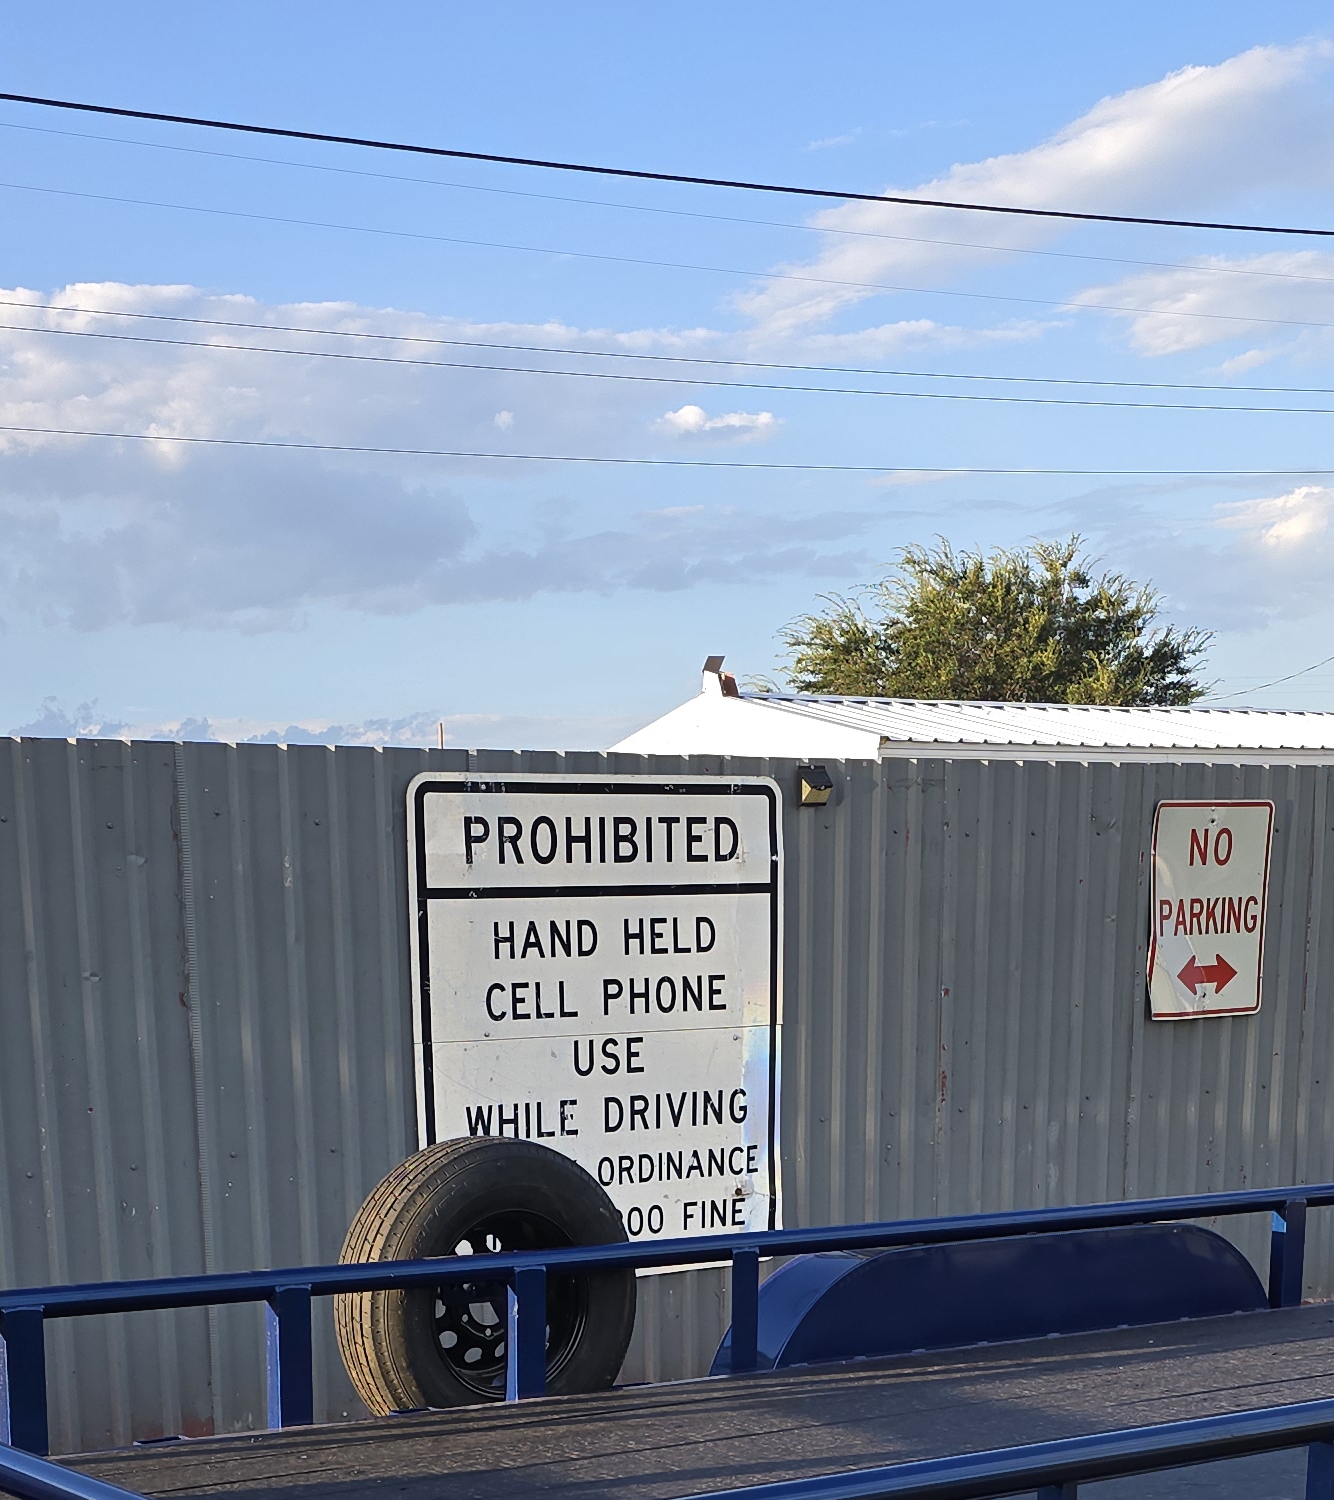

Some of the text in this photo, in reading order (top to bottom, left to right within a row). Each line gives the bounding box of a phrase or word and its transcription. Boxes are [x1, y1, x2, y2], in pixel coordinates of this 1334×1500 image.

[463, 815, 740, 865] PROHIBITED
[1189, 827, 1233, 866] NO
[493, 916, 717, 960] HAND HELD
[1159, 896, 1259, 937] PARKING
[485, 974, 727, 1022] CELL PHONE
[573, 1036, 645, 1077] USE
[466, 1088, 748, 1139] WHILE DRIVING
[597, 1144, 759, 1187] ORDINANCE
[619, 1198, 746, 1236] 00 FINE
